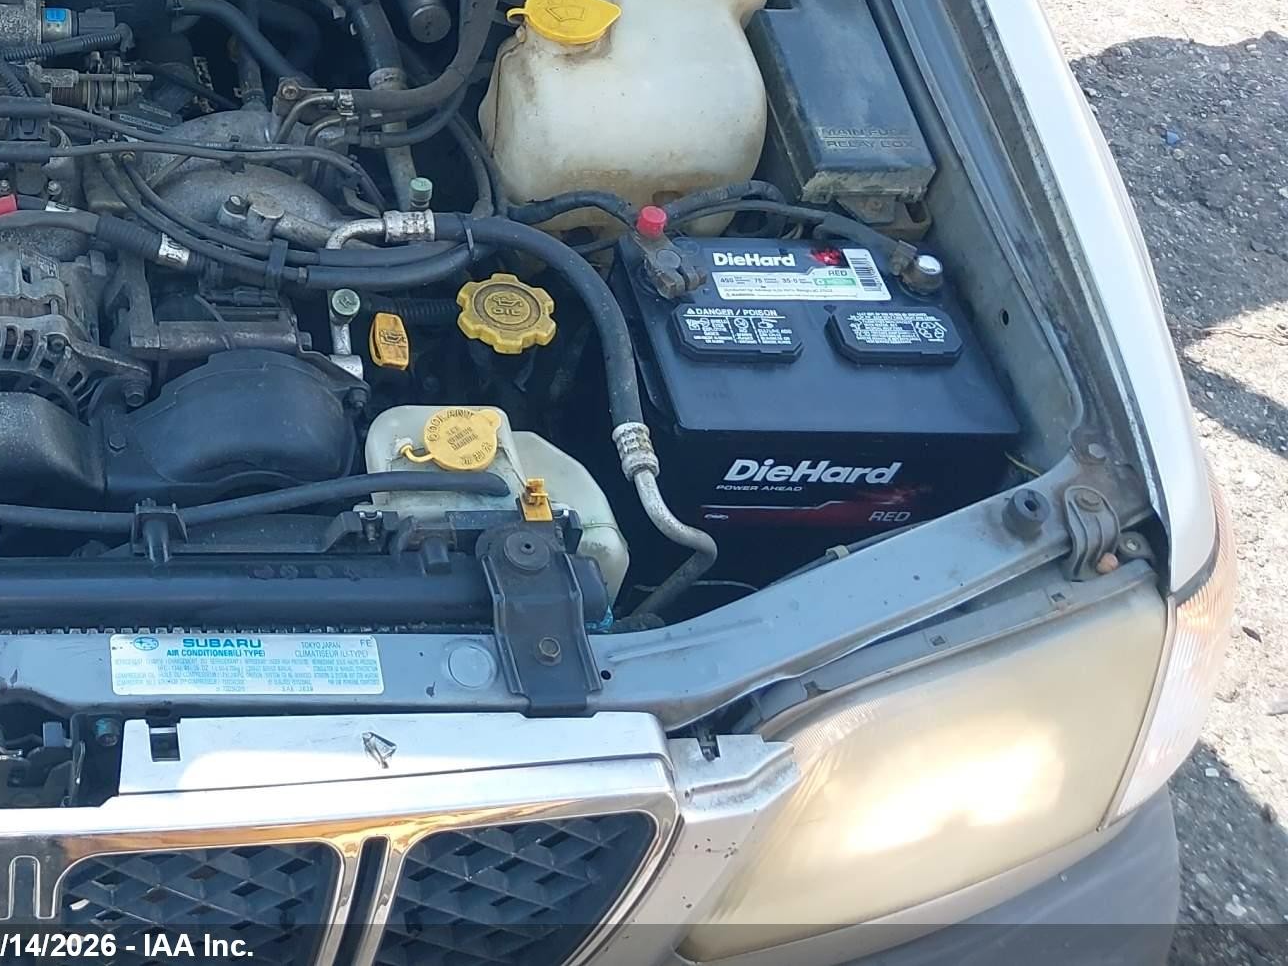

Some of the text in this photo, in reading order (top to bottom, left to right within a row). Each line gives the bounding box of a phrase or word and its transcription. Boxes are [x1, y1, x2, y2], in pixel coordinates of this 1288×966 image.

[711, 251, 796, 267] DieHard
[492, 307, 521, 316] OIL
[695, 308, 734, 316] DANGER
[723, 458, 903, 484] DieHard
[867, 510, 912, 522] RED
[182, 637, 262, 648] SUBARU
[166, 649, 180, 657] AIR
